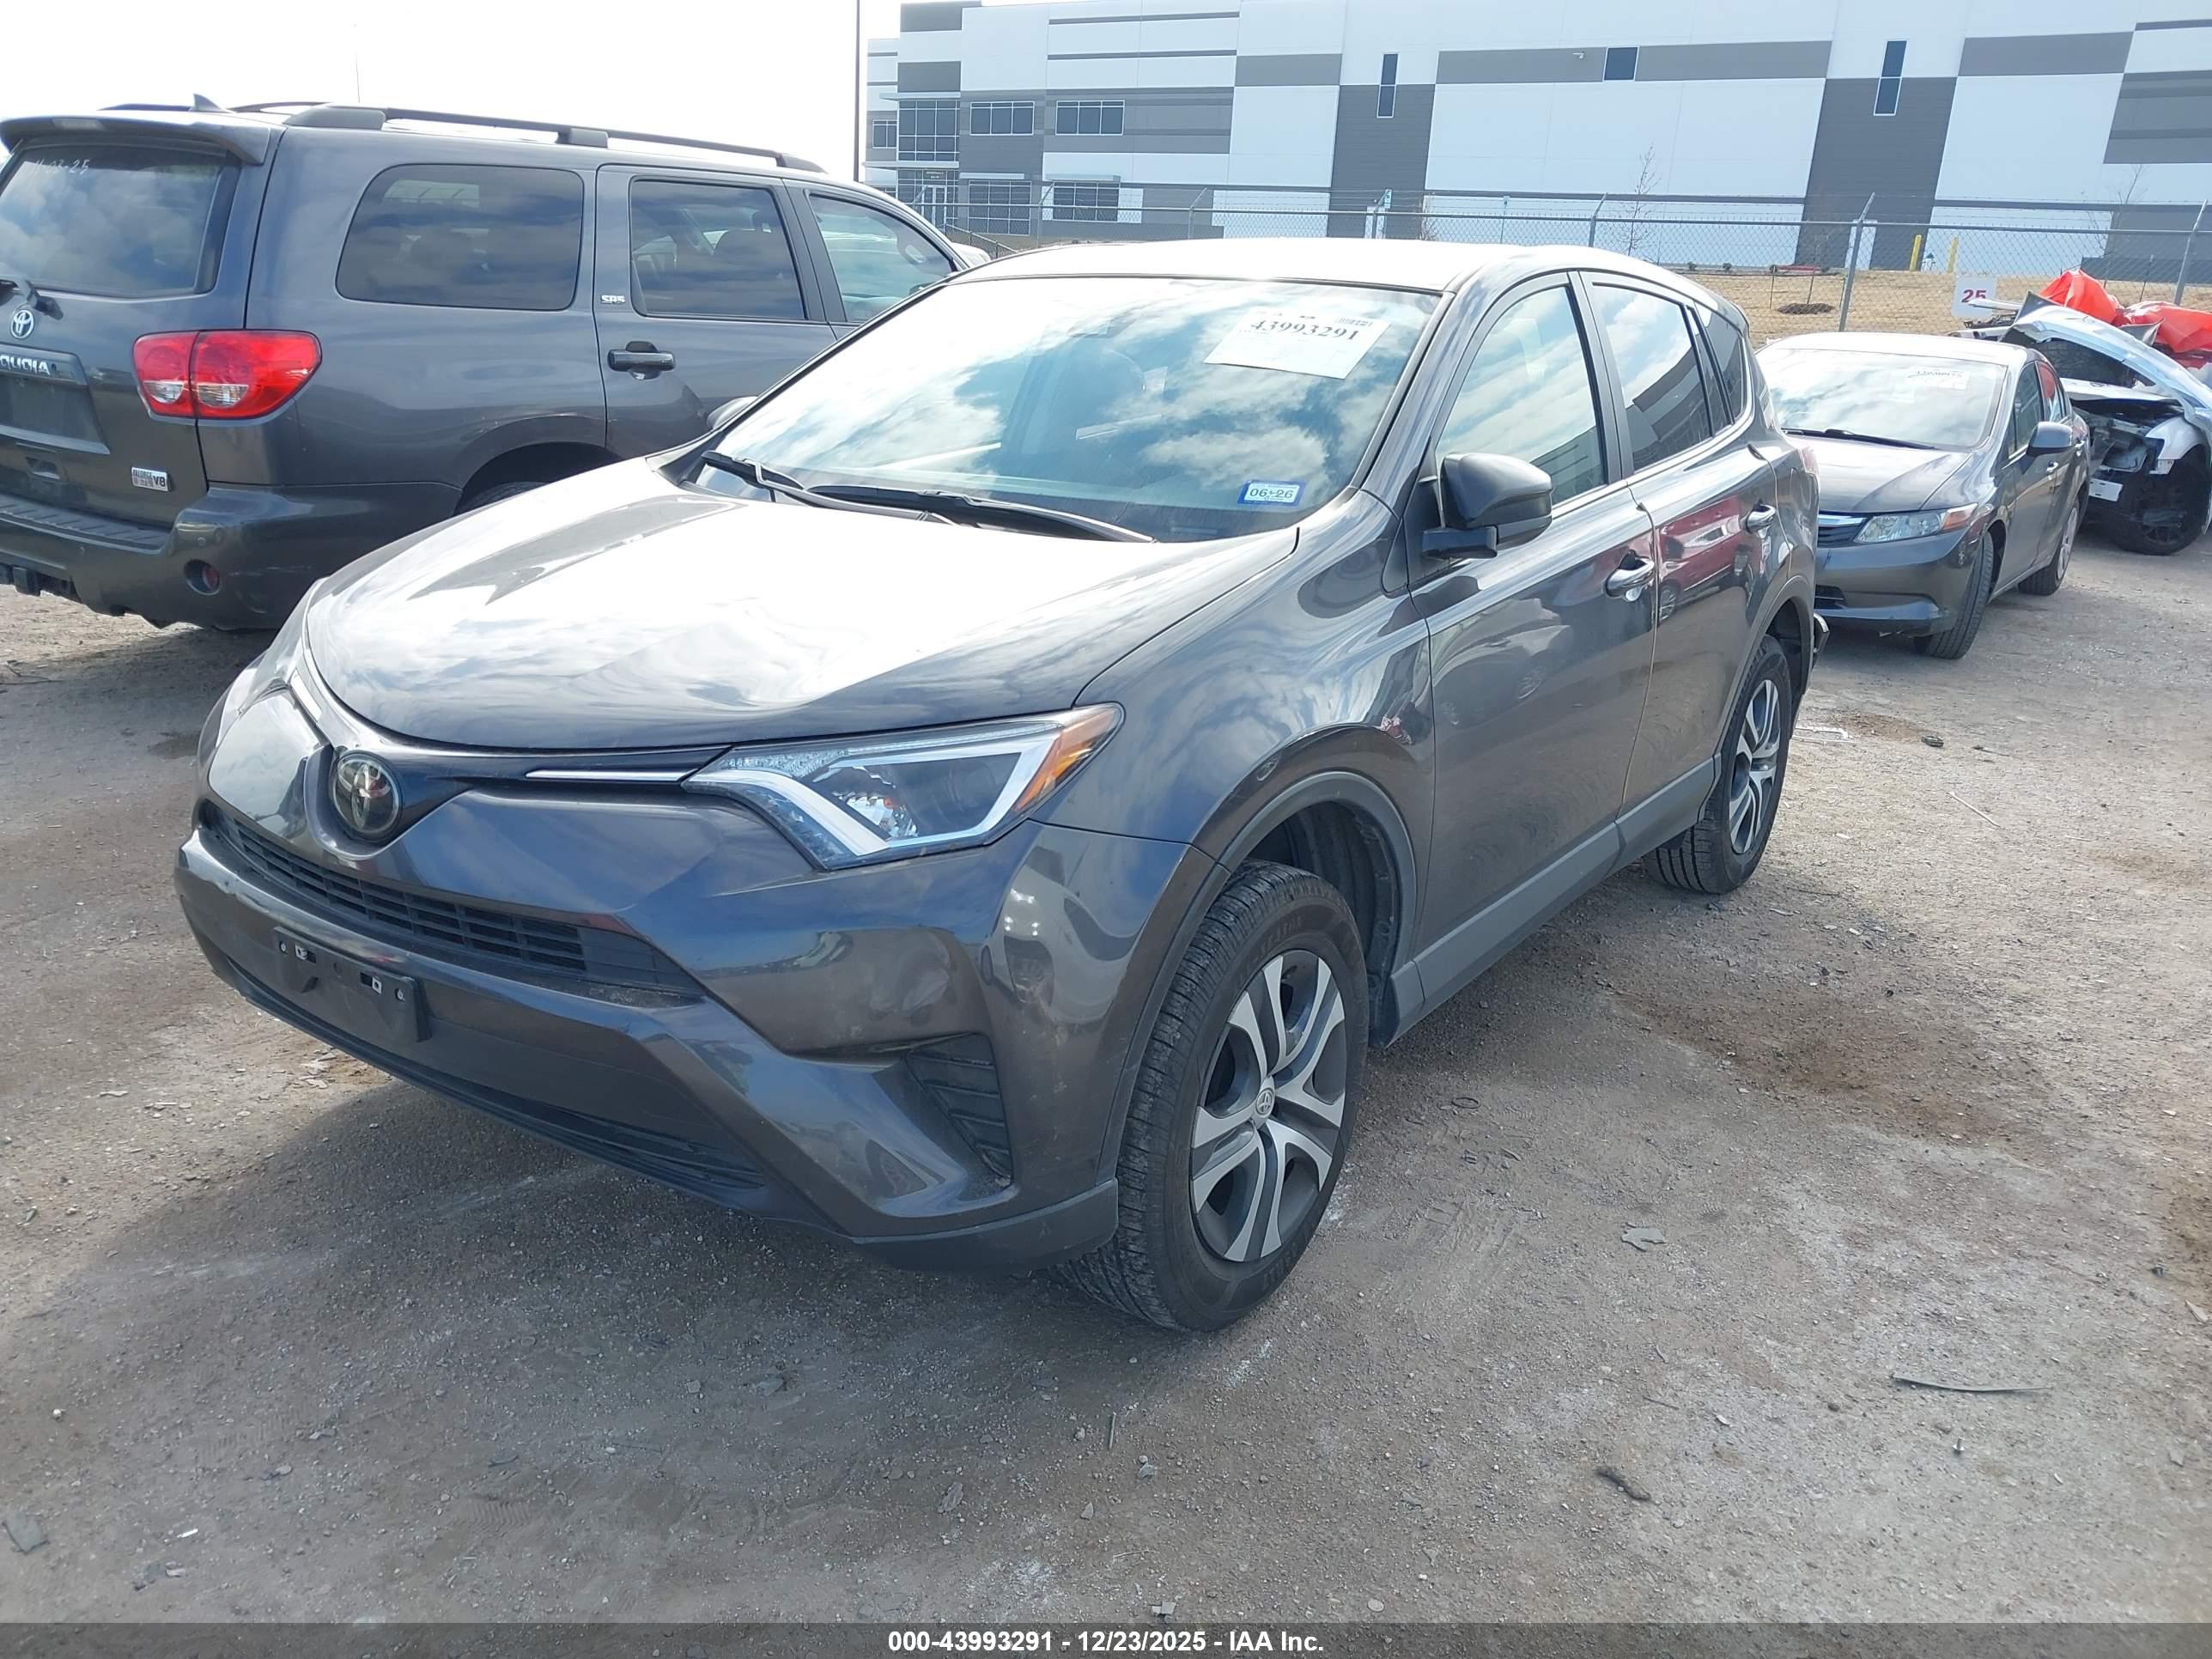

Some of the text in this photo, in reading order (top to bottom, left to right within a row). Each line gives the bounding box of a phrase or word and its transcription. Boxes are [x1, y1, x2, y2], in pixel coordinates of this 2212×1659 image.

[1961, 289, 1987, 303] 25
[1250, 319, 1360, 341] 43993291
[151, 475, 166, 488] V8
